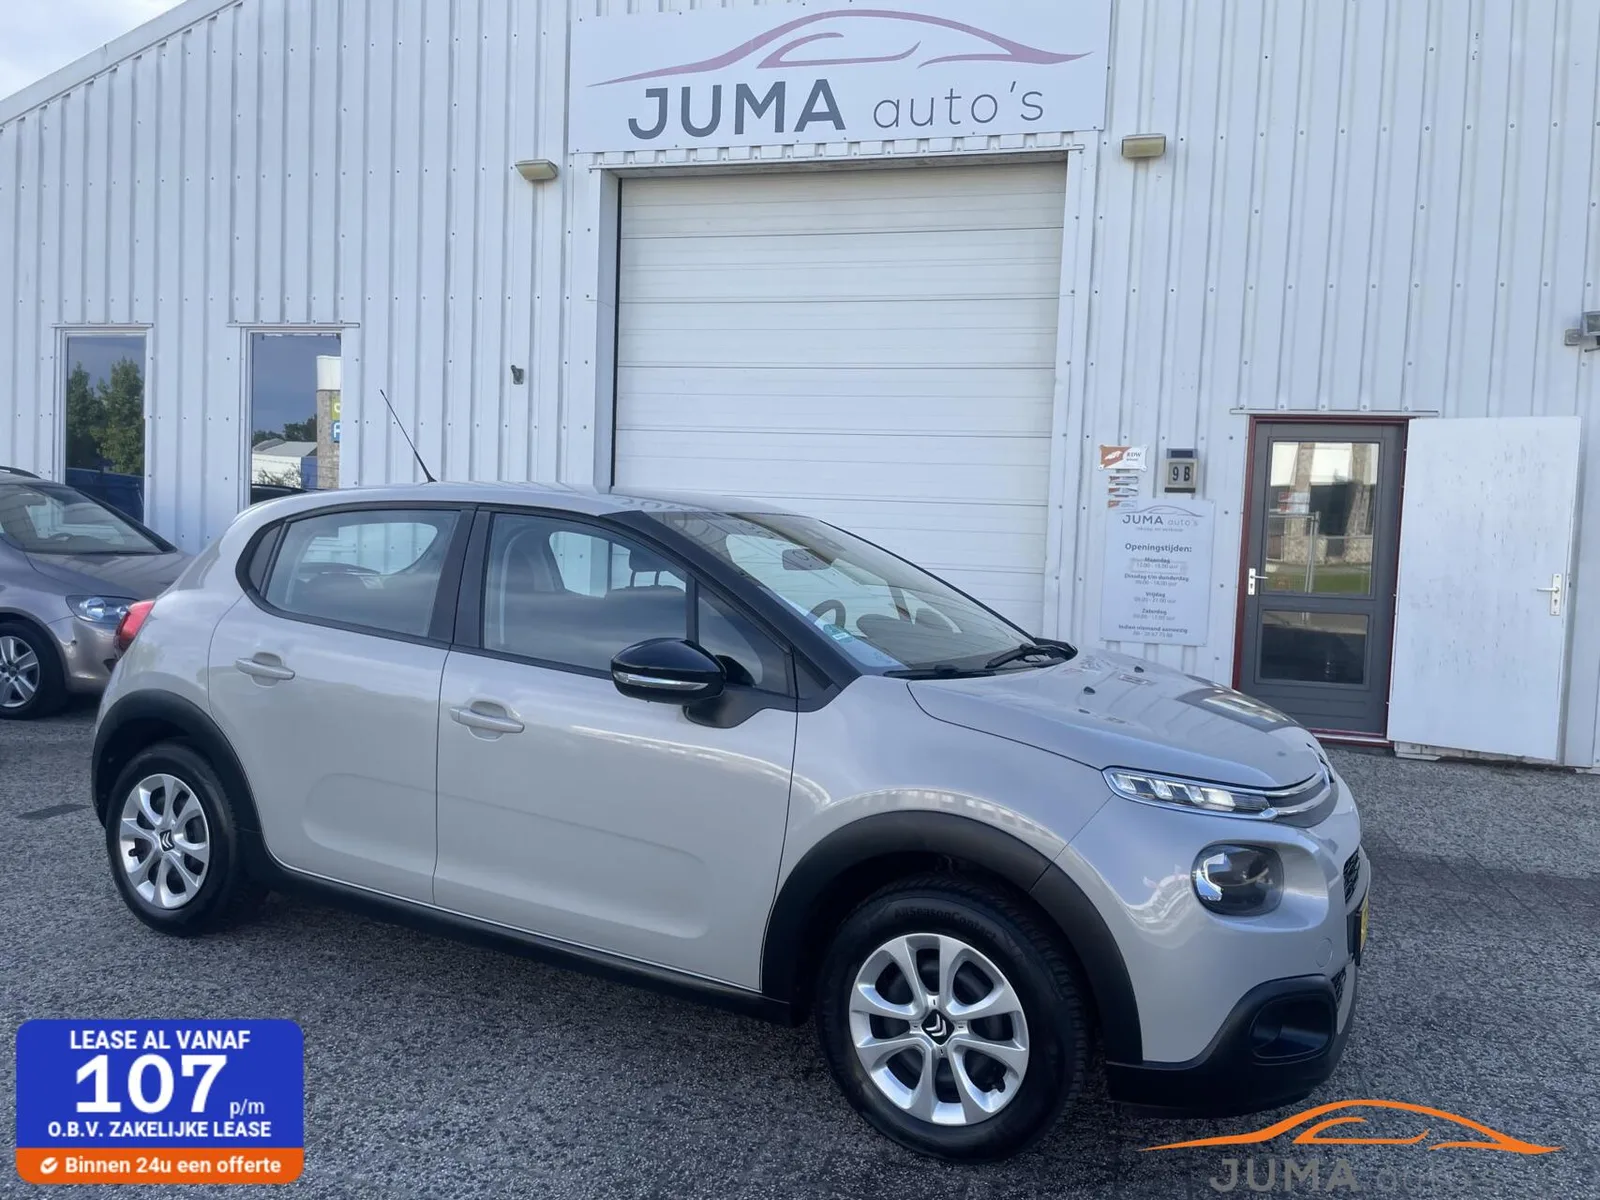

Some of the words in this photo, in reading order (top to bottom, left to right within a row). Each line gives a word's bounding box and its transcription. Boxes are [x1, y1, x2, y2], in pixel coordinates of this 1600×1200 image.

[628, 78, 846, 140] JUMA
[872, 81, 1044, 129] auto's
[1172, 466, 1179, 481] 9
[1183, 465, 1190, 481] B
[1122, 514, 1164, 525] JUMA
[1124, 542, 1192, 553] Openingstijden:
